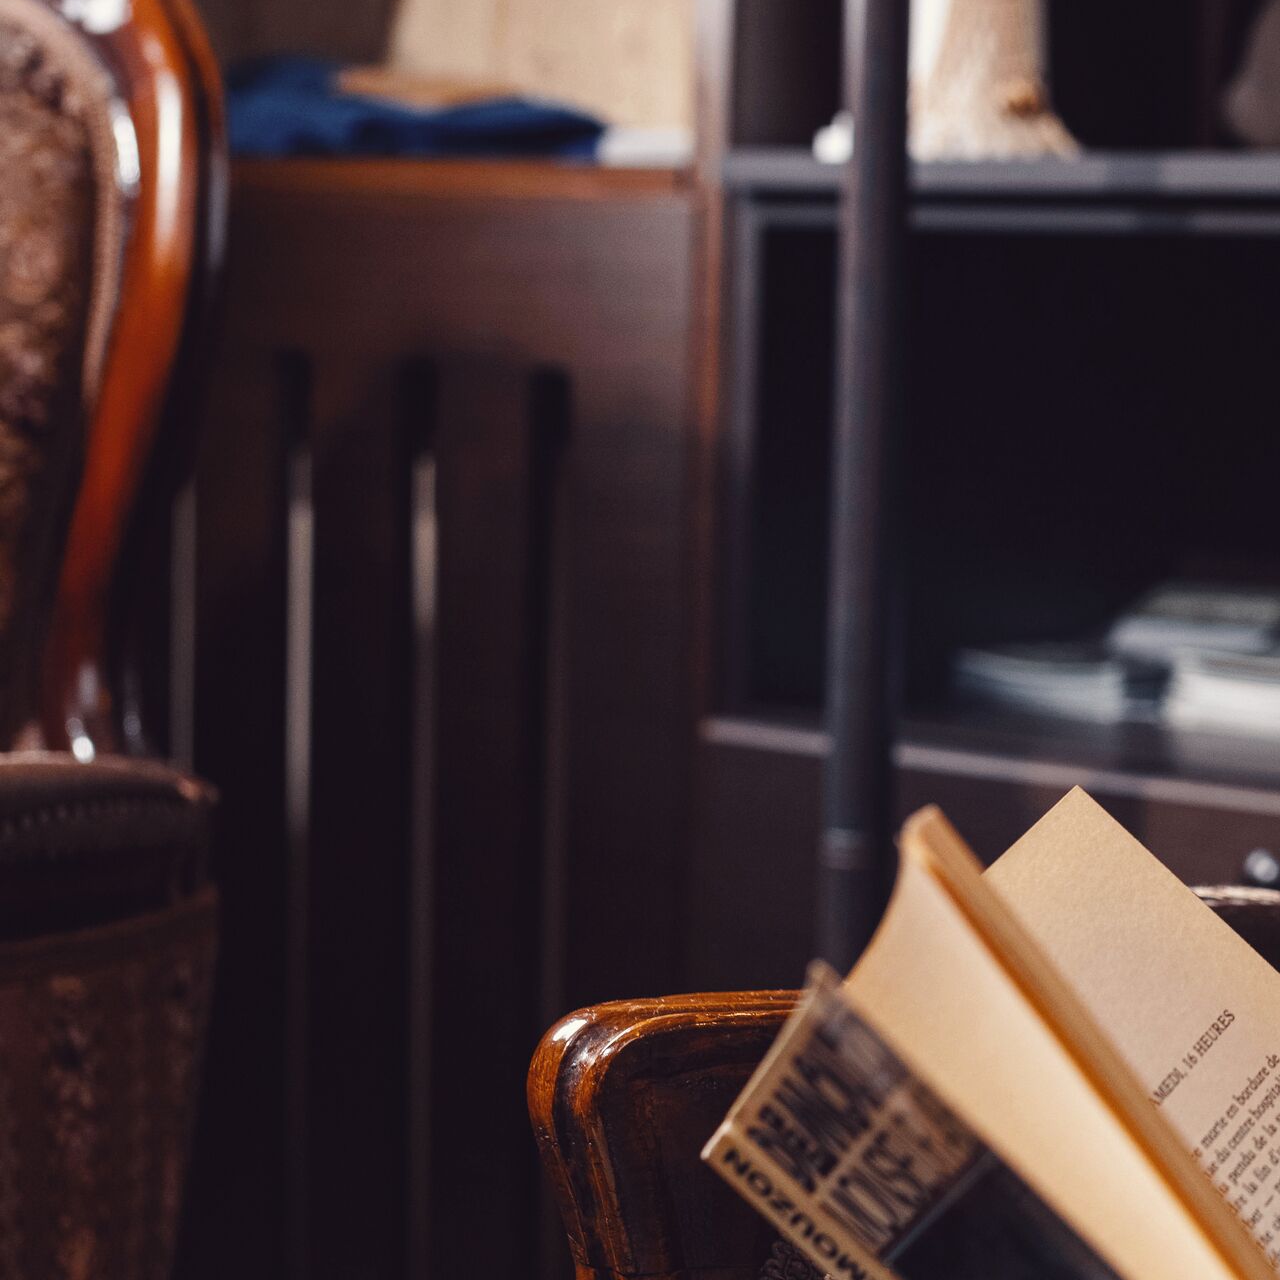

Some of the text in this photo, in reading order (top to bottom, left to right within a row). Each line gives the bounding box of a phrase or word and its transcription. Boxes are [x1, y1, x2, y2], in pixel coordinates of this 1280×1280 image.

[1181, 1051, 1199, 1071] 16
[1191, 1007, 1236, 1059] HEURES
[1264, 1053, 1280, 1070] de
[1231, 1065, 1271, 1107] bordure
[1224, 1102, 1240, 1121] en
[1226, 1116, 1257, 1152] centre
[1226, 1148, 1258, 1188] pendu
[1251, 1134, 1269, 1153] de
[1260, 1123, 1279, 1139] la
